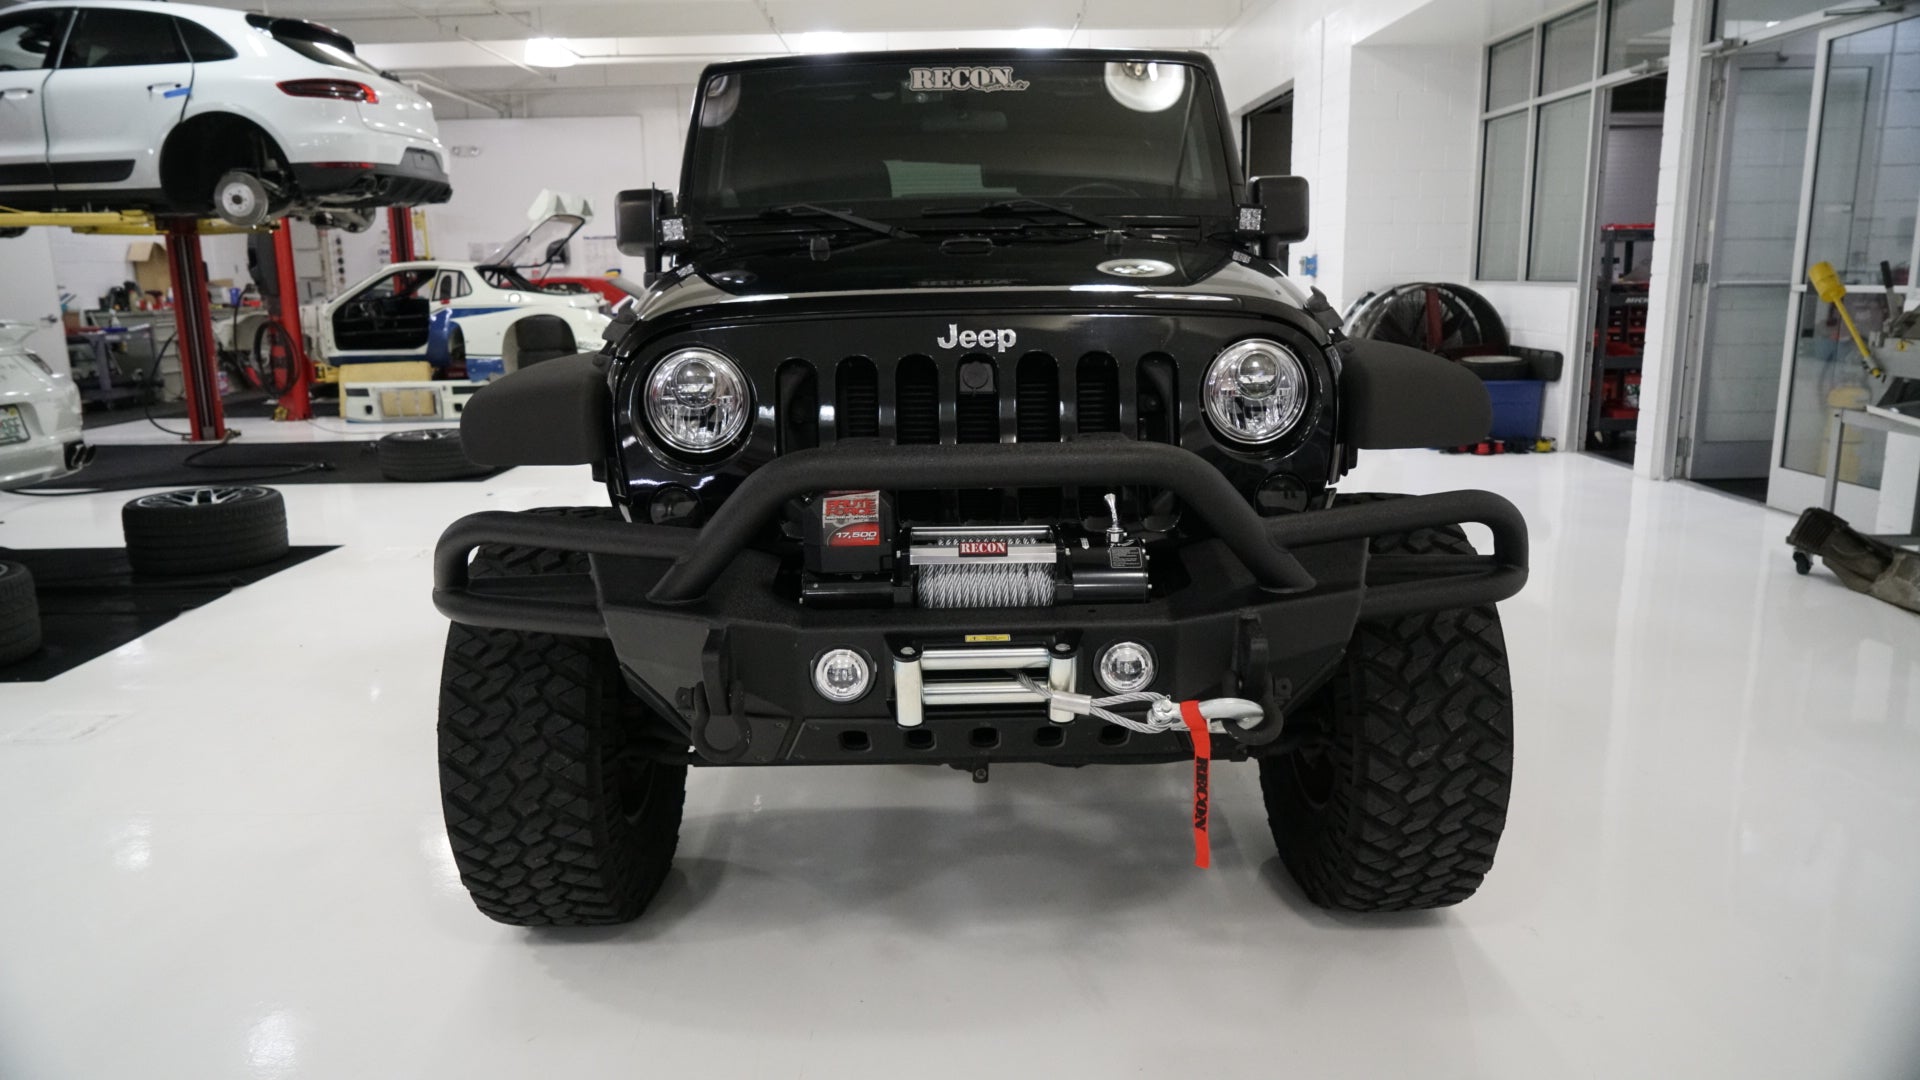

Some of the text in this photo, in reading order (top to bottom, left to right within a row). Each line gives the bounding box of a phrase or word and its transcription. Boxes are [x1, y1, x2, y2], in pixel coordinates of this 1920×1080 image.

[911, 67, 1012, 90] RECON
[937, 323, 1017, 353] Jeep
[835, 531, 877, 539] 17,500
[961, 542, 1006, 553] RECON
[1195, 756, 1208, 832] RECON
